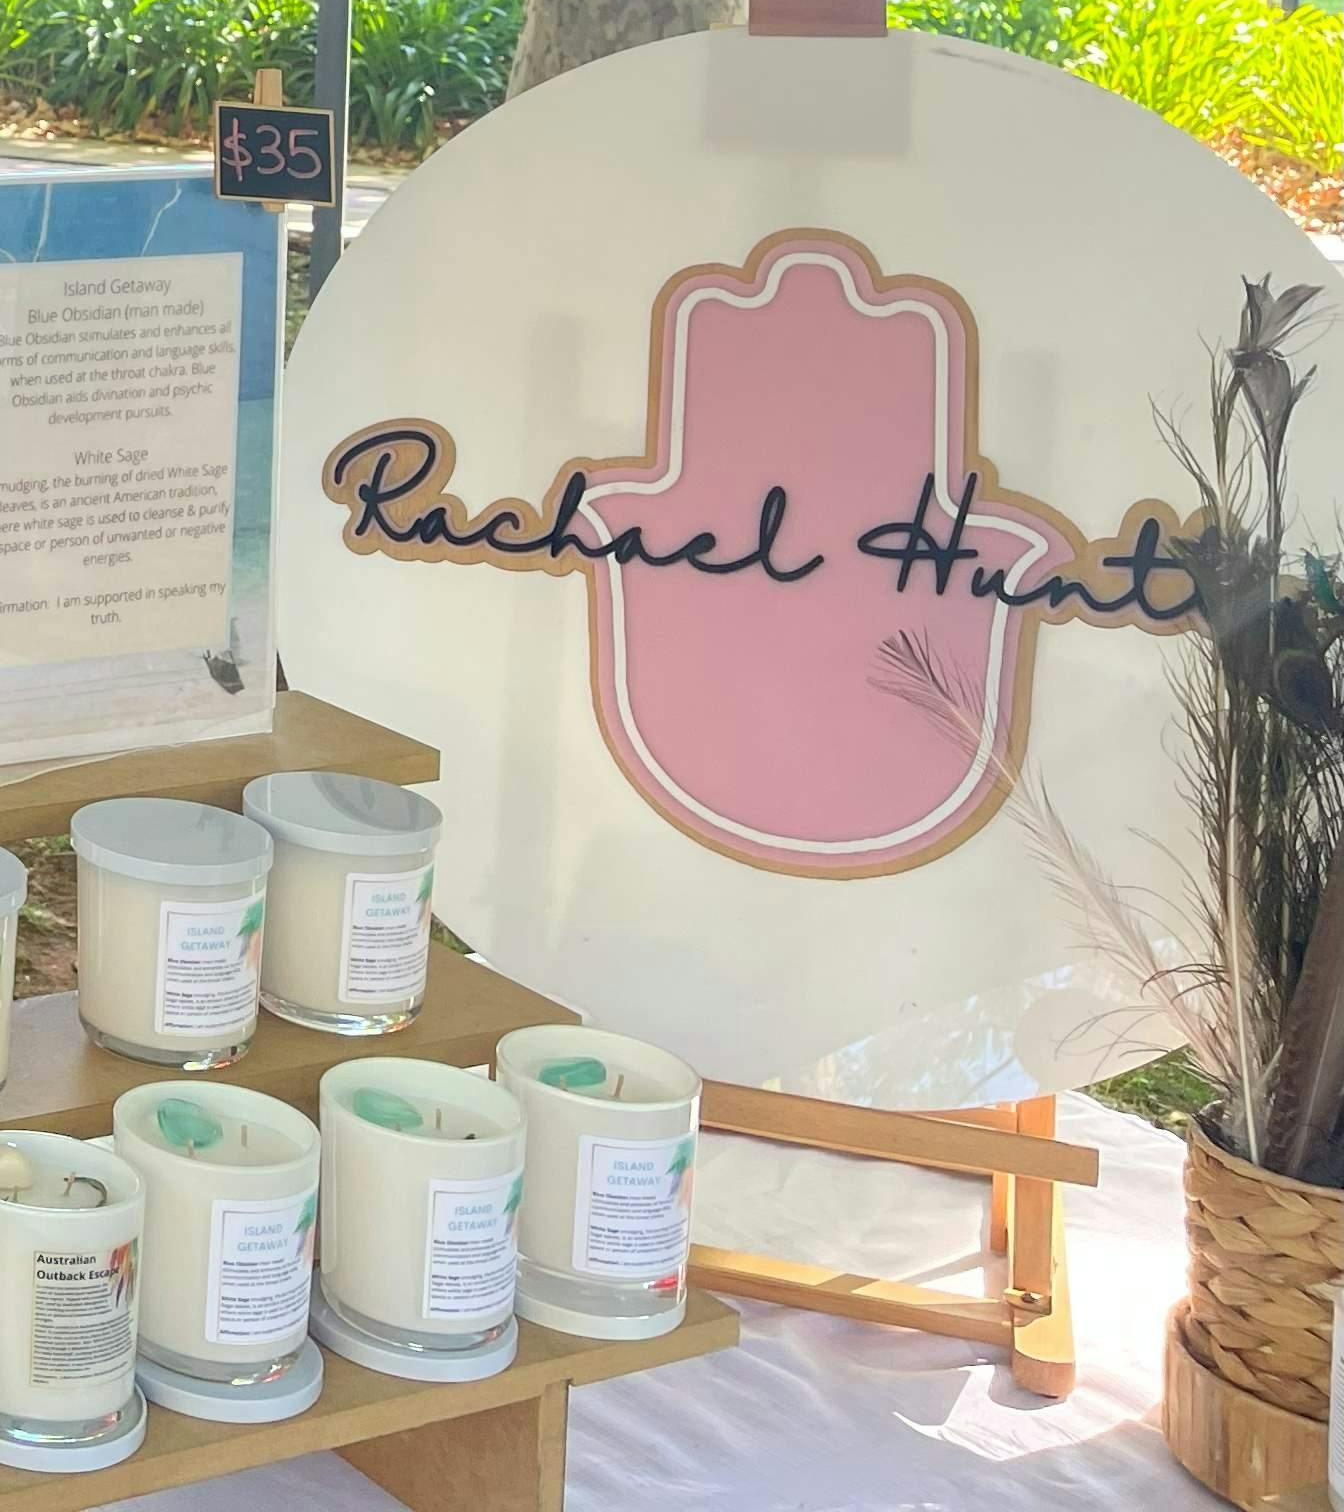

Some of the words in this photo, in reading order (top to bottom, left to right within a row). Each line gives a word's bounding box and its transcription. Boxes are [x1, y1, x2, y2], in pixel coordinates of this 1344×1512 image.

[222, 117, 322, 182] $35
[63, 278, 107, 297] Island
[109, 275, 172, 297] Getaway
[27, 308, 59, 326] Blue
[61, 304, 123, 323] Obsidian
[123, 303, 160, 323] (man
[161, 299, 205, 318] made)
[73, 449, 114, 467] White
[116, 447, 149, 467] Sage
[334, 430, 825, 583] Rachael
[857, 471, 1207, 621] Hunt
[56, 595, 61, 609] I
[63, 595, 81, 609] am
[84, 588, 143, 610] supported
[144, 587, 156, 601] in
[157, 583, 208, 601] speaking
[208, 582, 227, 596] my
[90, 609, 122, 625] truth.
[371, 892, 407, 903] ISLAND
[365, 906, 411, 918] GETAWAY
[186, 926, 225, 937] ISLAND
[180, 940, 231, 951] GETAWAY
[613, 1160, 655, 1172] ISLAND
[606, 1175, 662, 1187] GETAWAY
[454, 1203, 493, 1216] ISLAND
[244, 1223, 284, 1236] ISLAND
[447, 1218, 497, 1232] GETAWAY
[237, 1239, 288, 1252] GETAWAY
[36, 1254, 97, 1266] Australian
[36, 1269, 87, 1281] Outback
